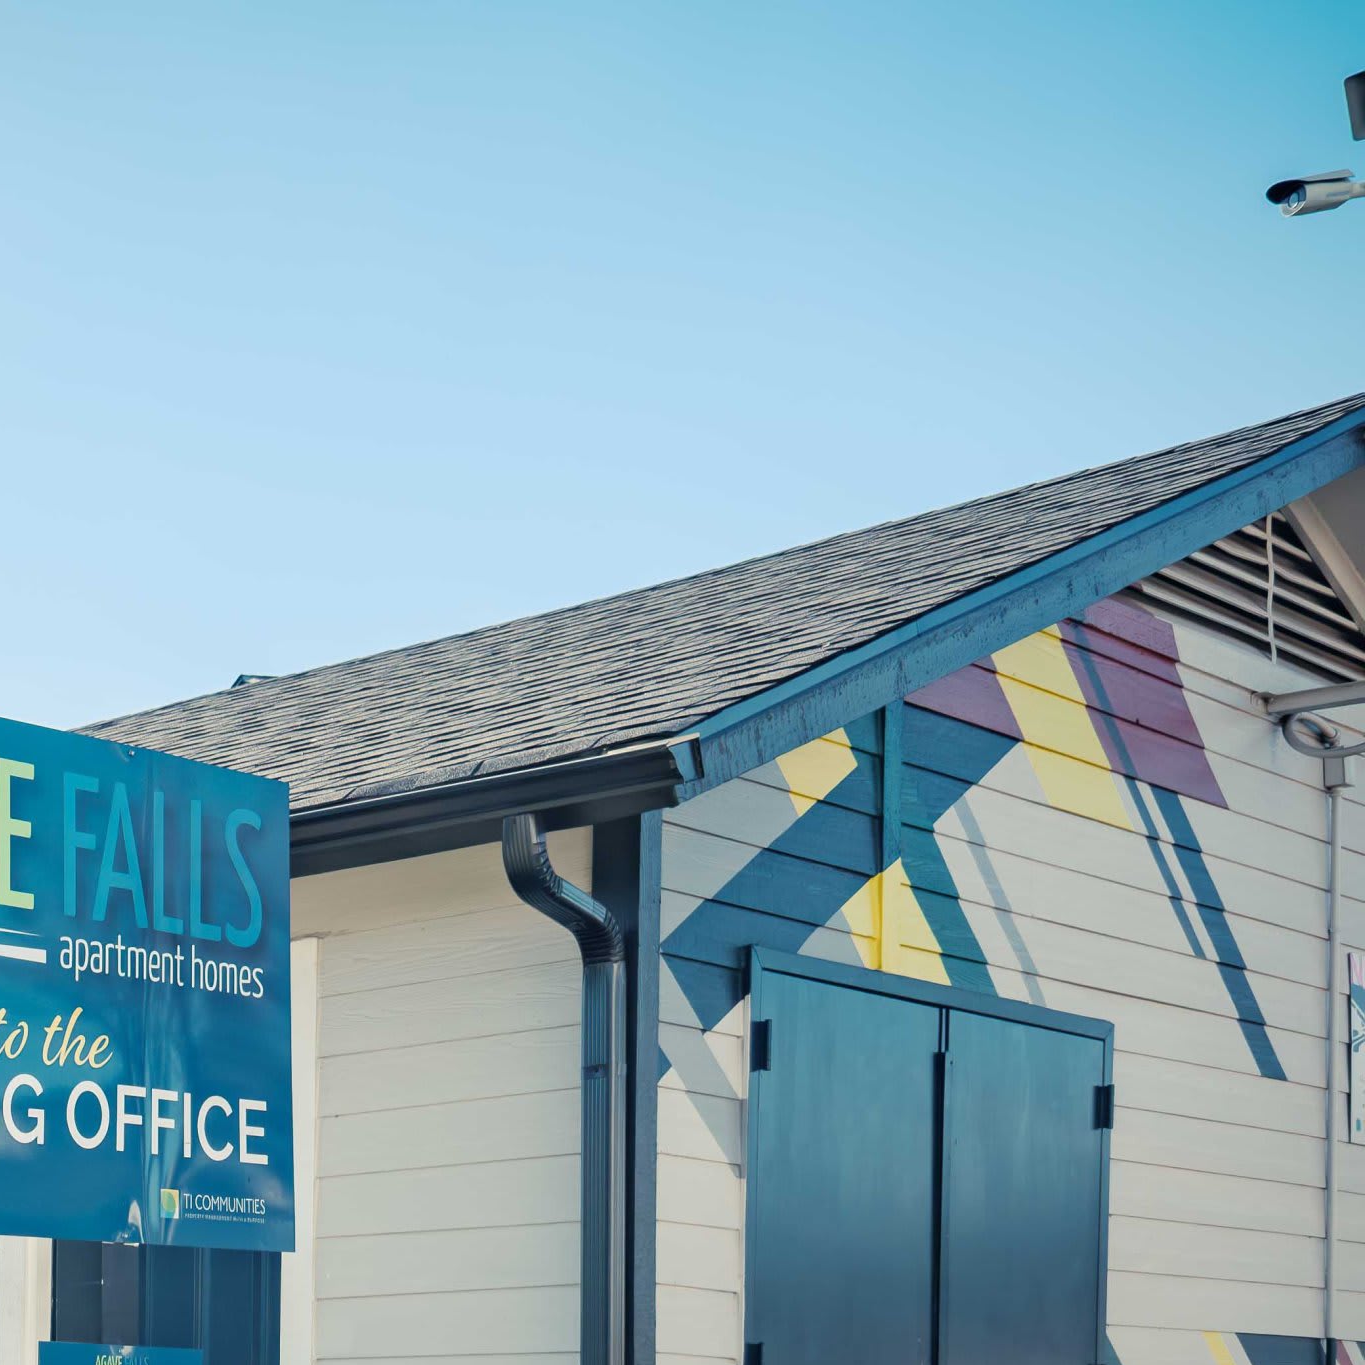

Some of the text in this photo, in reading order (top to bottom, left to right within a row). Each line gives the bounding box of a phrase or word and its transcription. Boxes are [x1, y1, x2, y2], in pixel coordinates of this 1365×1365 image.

[62, 770, 264, 948] FALLS
[59, 936, 264, 999] apartment homes
[42, 1007, 113, 1069] the
[66, 1081, 269, 1166] OFFICE
[183, 1193, 266, 1215] TI COMMUNITIES
